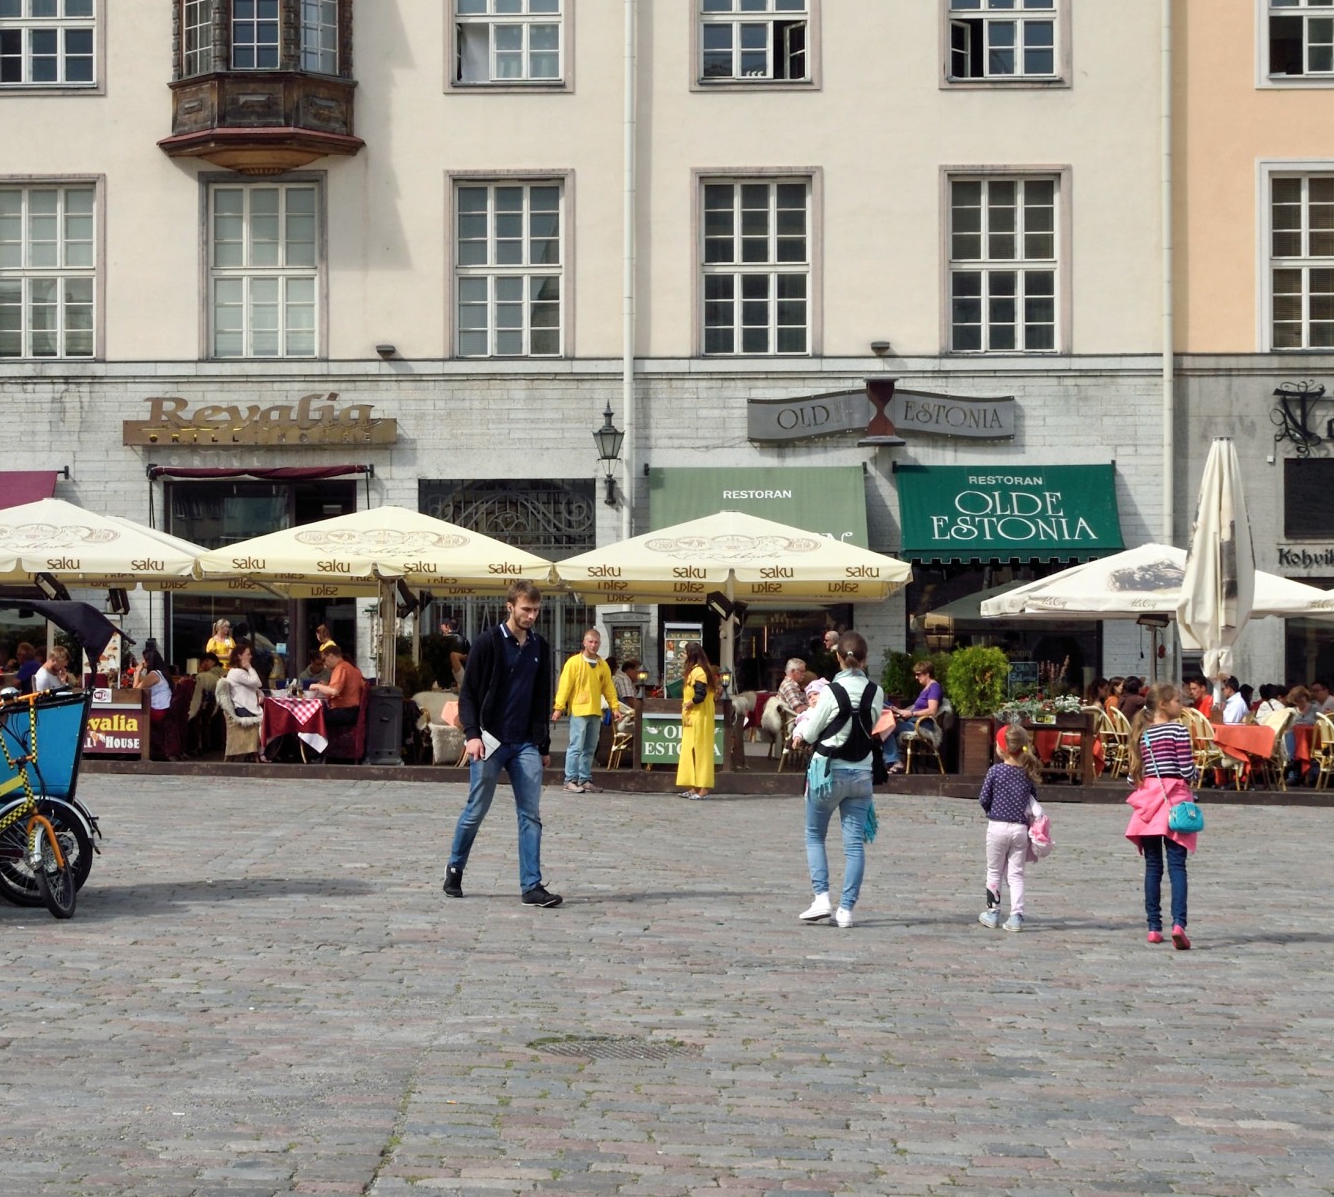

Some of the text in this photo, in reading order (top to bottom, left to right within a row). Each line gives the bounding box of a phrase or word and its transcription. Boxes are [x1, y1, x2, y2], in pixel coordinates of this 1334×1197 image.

[144, 391, 381, 431] Revalia
[904, 401, 1003, 429] ESTONIA
[968, 475, 1043, 486] RESTORAN
[723, 490, 792, 499] RESTORAN
[955, 491, 1064, 516] OLDE
[930, 516, 1098, 541] ESTONIA
[47, 556, 80, 570] saku
[131, 557, 164, 571] saku
[232, 556, 266, 570] saku
[317, 559, 351, 573] saku
[403, 560, 437, 574] saku
[488, 561, 522, 575] saku
[588, 564, 621, 578] saku
[673, 565, 707, 579] saku
[760, 565, 794, 579] saku
[845, 564, 879, 579] saku
[88, 714, 139, 732] valia
